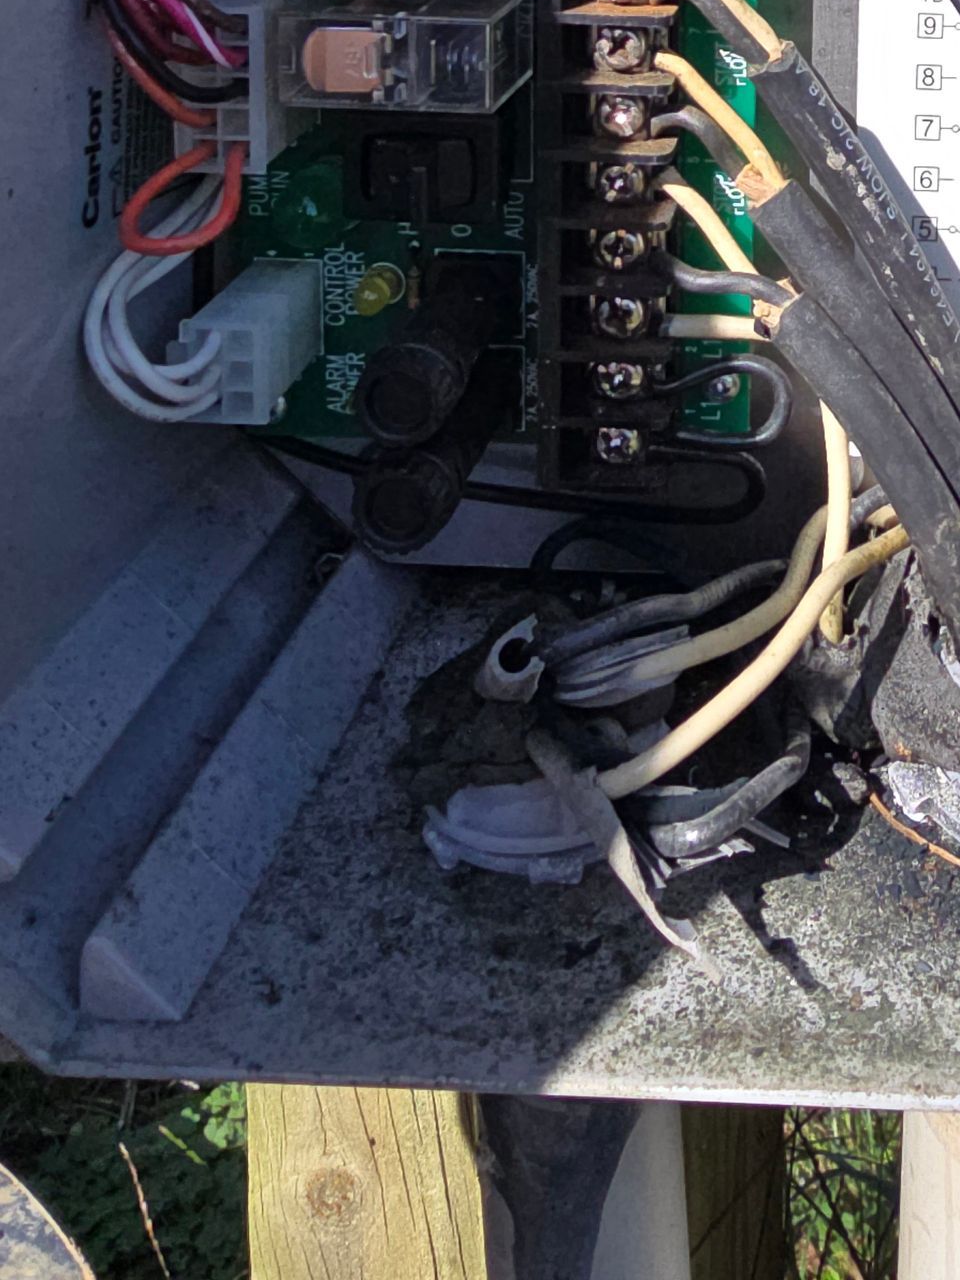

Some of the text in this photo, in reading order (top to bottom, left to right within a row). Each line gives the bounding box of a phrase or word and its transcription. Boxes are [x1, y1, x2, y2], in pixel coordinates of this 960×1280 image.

[923, 16, 937, 35] 9
[922, 67, 935, 86] 8
[111, 58, 123, 144] CAUTIO
[921, 119, 934, 137] 7
[82, 88, 103, 229] Carlon
[247, 172, 270, 218] PUM
[919, 170, 933, 189] 6
[918, 220, 931, 238] 5
[323, 242, 346, 327] CONTROL
[325, 355, 347, 413] ALARM
